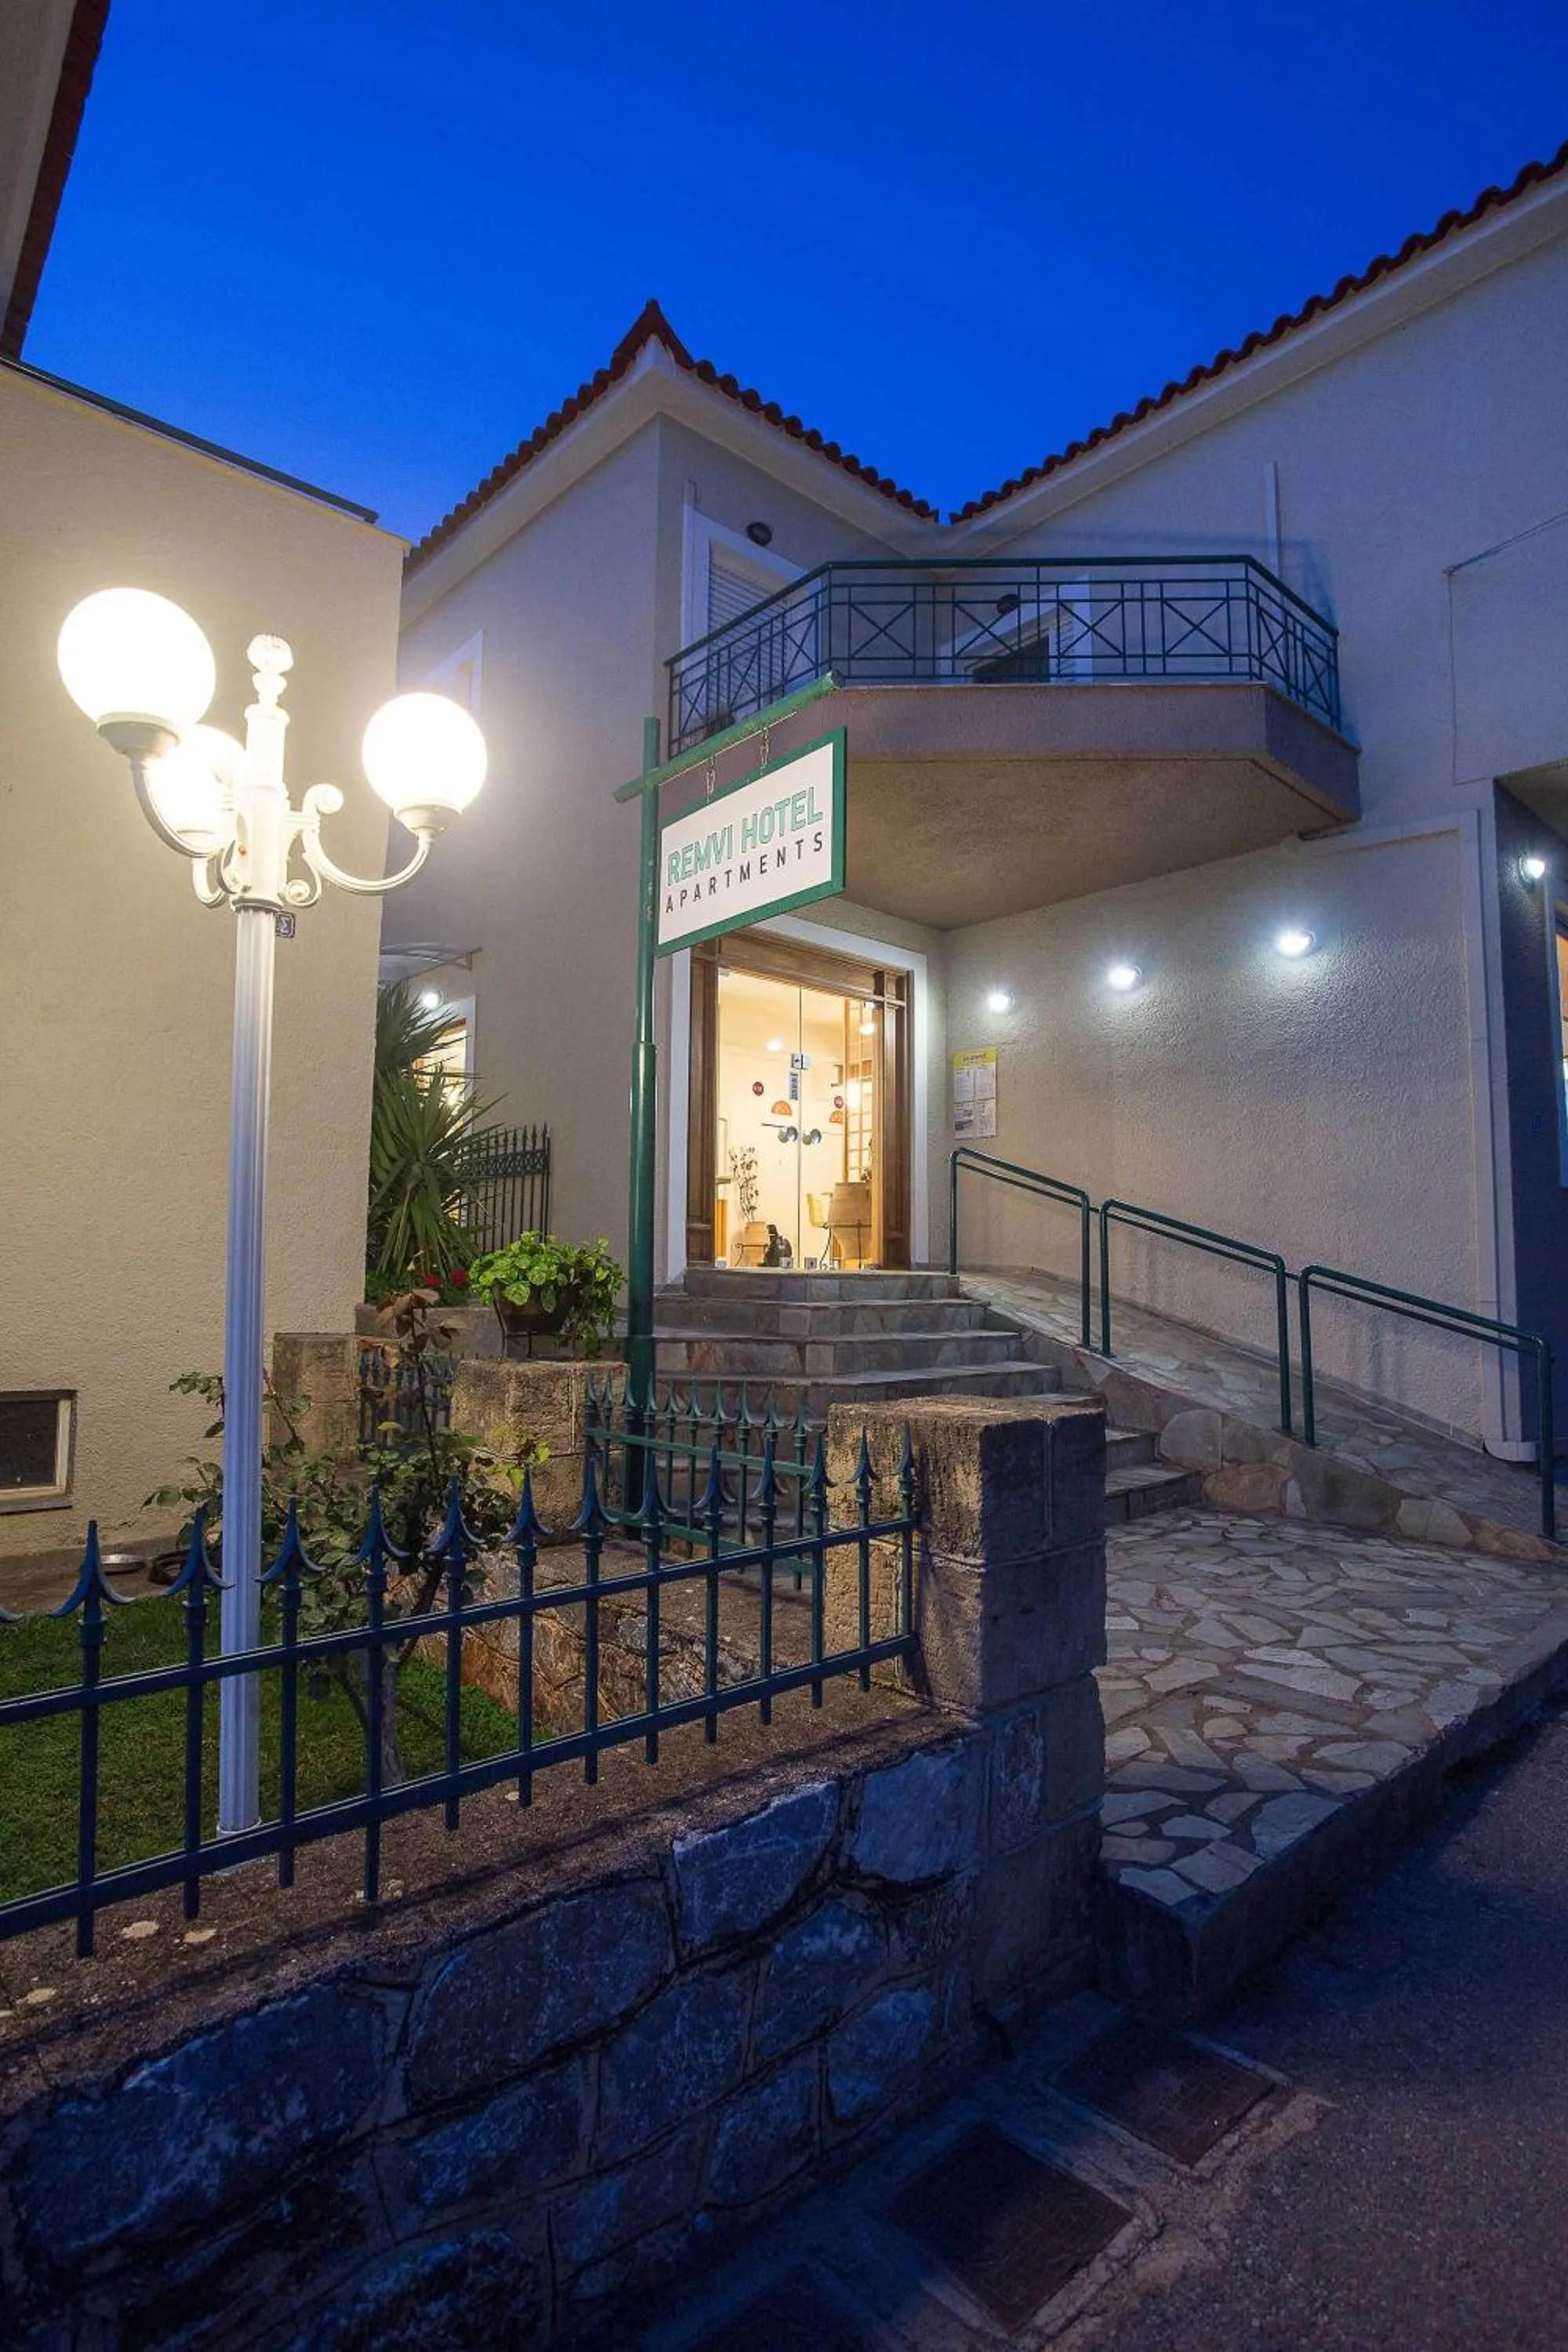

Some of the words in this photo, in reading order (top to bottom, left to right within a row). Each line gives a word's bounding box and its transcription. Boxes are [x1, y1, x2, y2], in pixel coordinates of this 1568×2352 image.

[666, 824, 733, 887] REMVI
[741, 786, 824, 854] HOTEL
[666, 831, 823, 913] APARTMENTS
